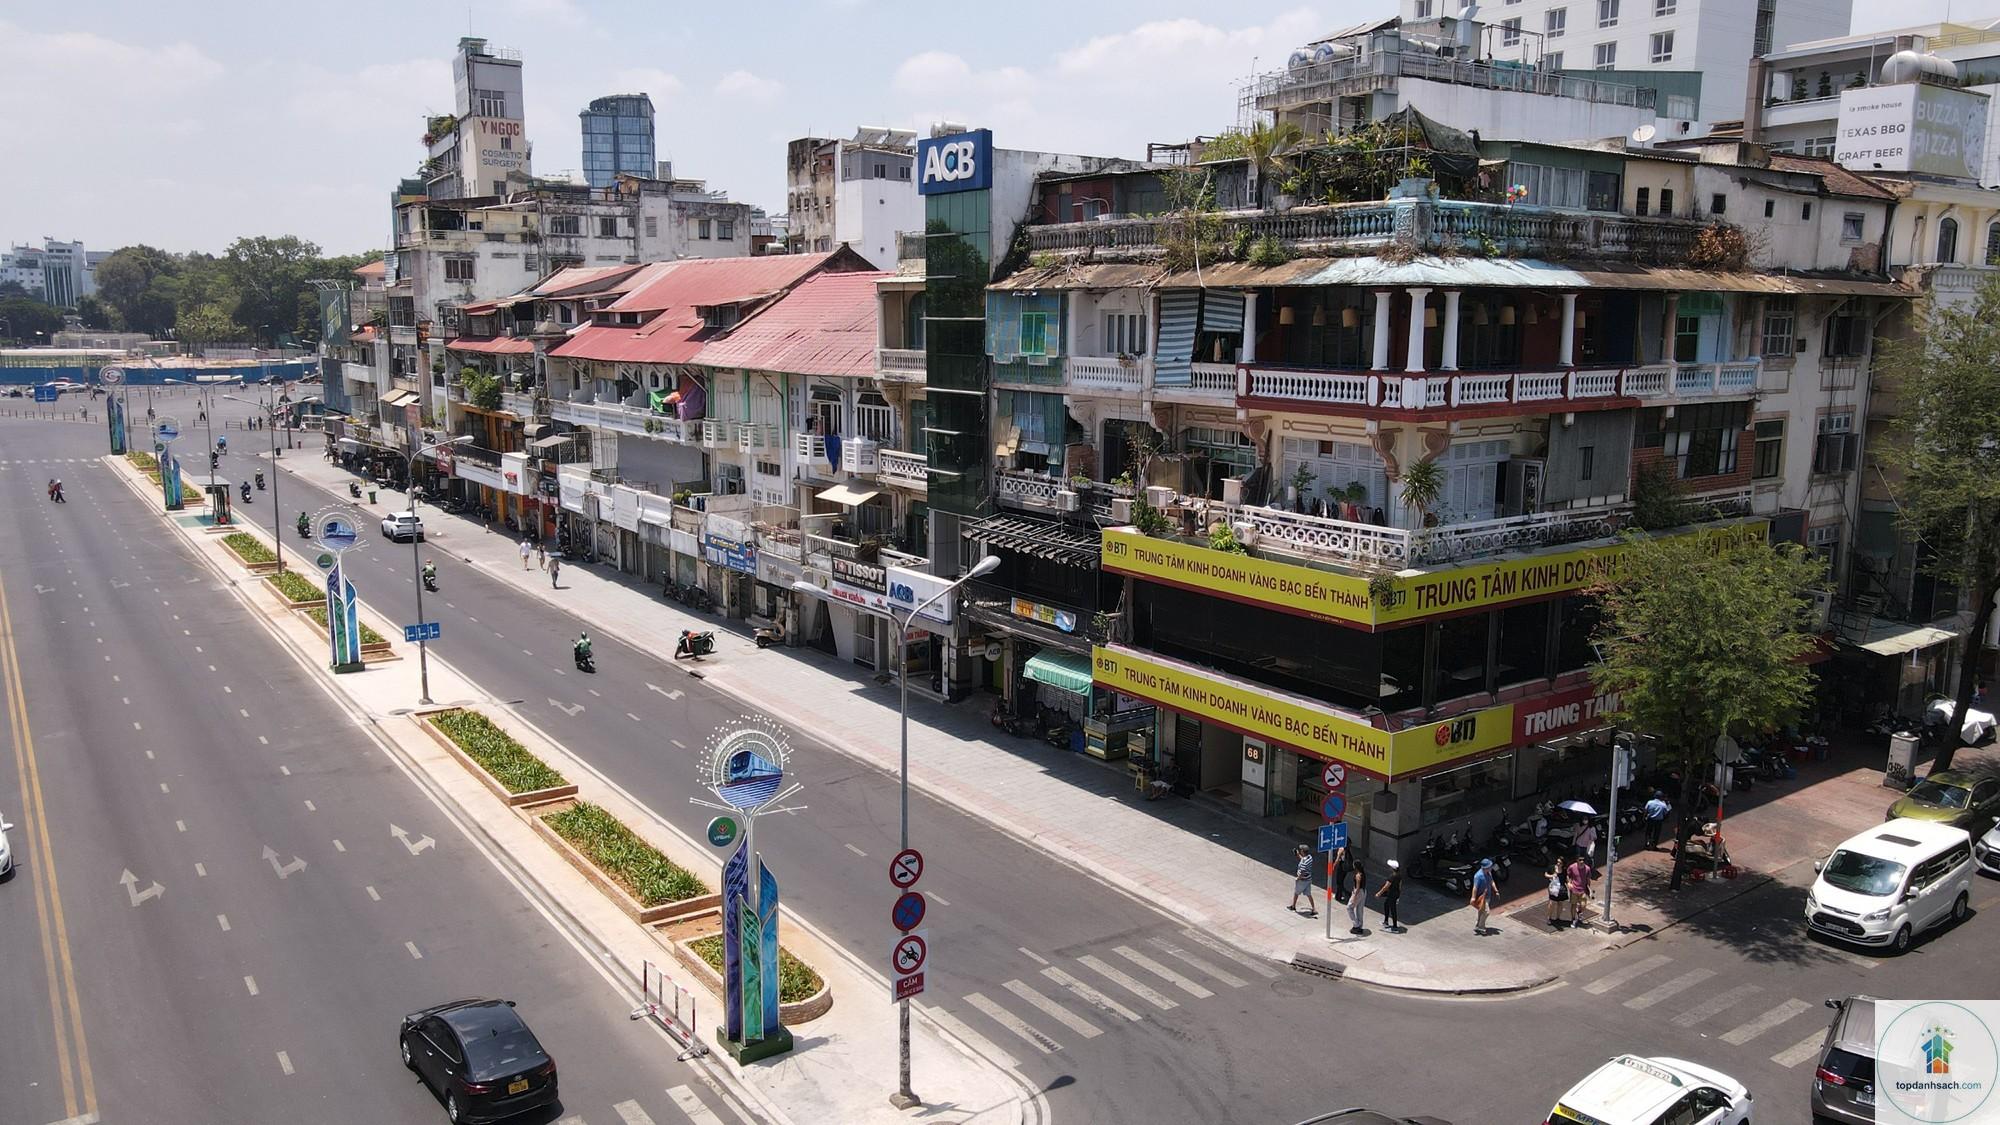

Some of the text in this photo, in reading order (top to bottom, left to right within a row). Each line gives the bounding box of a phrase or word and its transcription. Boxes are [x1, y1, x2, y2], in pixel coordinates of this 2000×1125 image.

[1856, 103, 1879, 112] smoke
[1881, 101, 1903, 110] house
[1917, 100, 1961, 127] BUZZA
[480, 120, 488, 134] Y
[1841, 123, 1906, 138] TEXAS BBQ
[482, 149, 522, 160] COSMETIC
[1837, 147, 1903, 161] CRAFT BEER
[1913, 130, 1958, 157] PIZZA
[482, 158, 522, 168] SURGERY
[922, 141, 976, 184] ACB
[847, 561, 885, 583] TISSOT
[1134, 548, 1164, 565] TRUNG
[1166, 553, 1185, 569] TÂM
[1187, 560, 1209, 575] KINH
[1212, 566, 1246, 583] DOANH
[1249, 571, 1277, 590] VÀNG
[1279, 579, 1302, 597] BẠC
[1304, 582, 1328, 602] BẾN
[1330, 586, 1369, 610] THÀNH
[1414, 576, 1476, 610] TRUNG
[1481, 567, 1517, 599] TÂM
[1521, 563, 1560, 591] KINH
[1563, 553, 1617, 584] DOANH
[889, 581, 914, 603] ACB
[1124, 667, 1157, 688] TRUNG
[1159, 676, 1180, 696] TÂM
[1182, 685, 1207, 705] KINH
[1210, 694, 1248, 718] DOANH
[1251, 705, 1282, 728] VÀNG
[1285, 716, 1310, 737] BẠC
[1313, 724, 1338, 746] BẾN
[1341, 734, 1385, 761] THÀNH
[1524, 702, 1580, 736] TRUNG
[1247, 747, 1259, 759] 68
